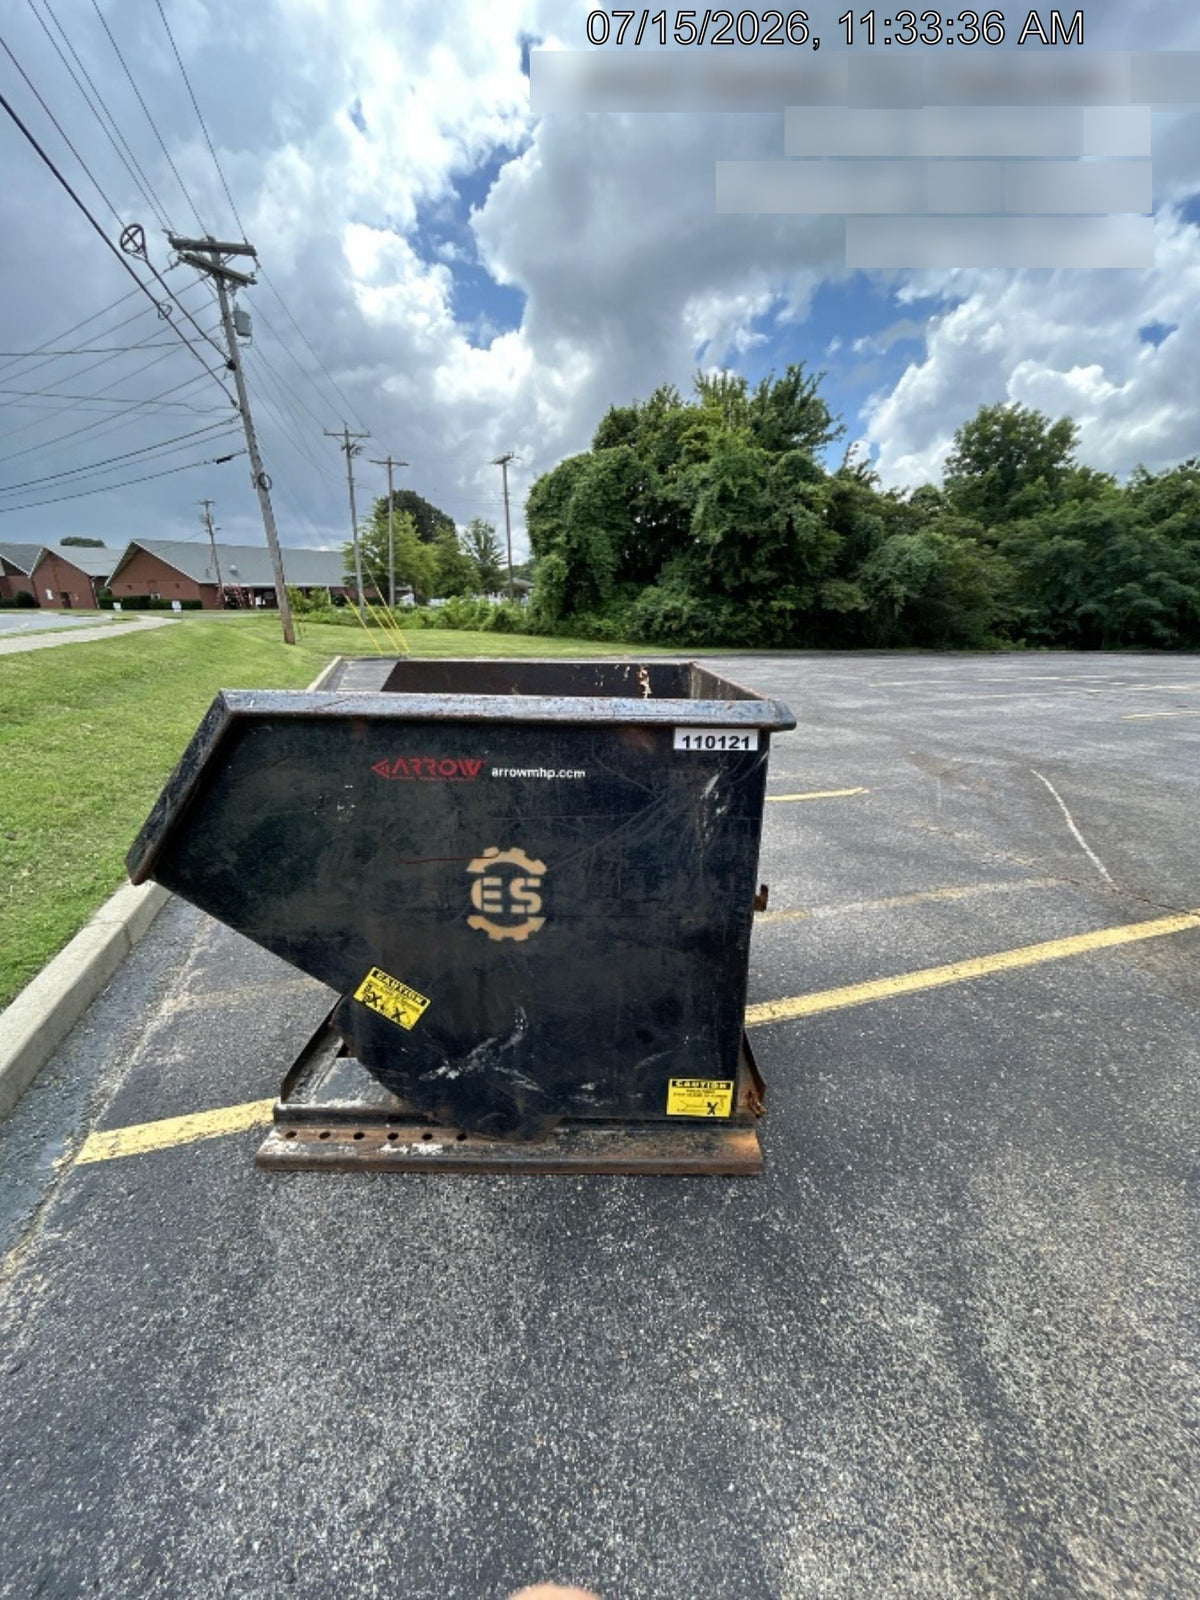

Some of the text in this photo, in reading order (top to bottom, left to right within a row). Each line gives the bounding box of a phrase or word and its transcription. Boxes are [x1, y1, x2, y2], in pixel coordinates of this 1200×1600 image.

[682, 735, 750, 749] 110121
[392, 757, 484, 776] ARROW
[471, 877, 542, 914] ES
